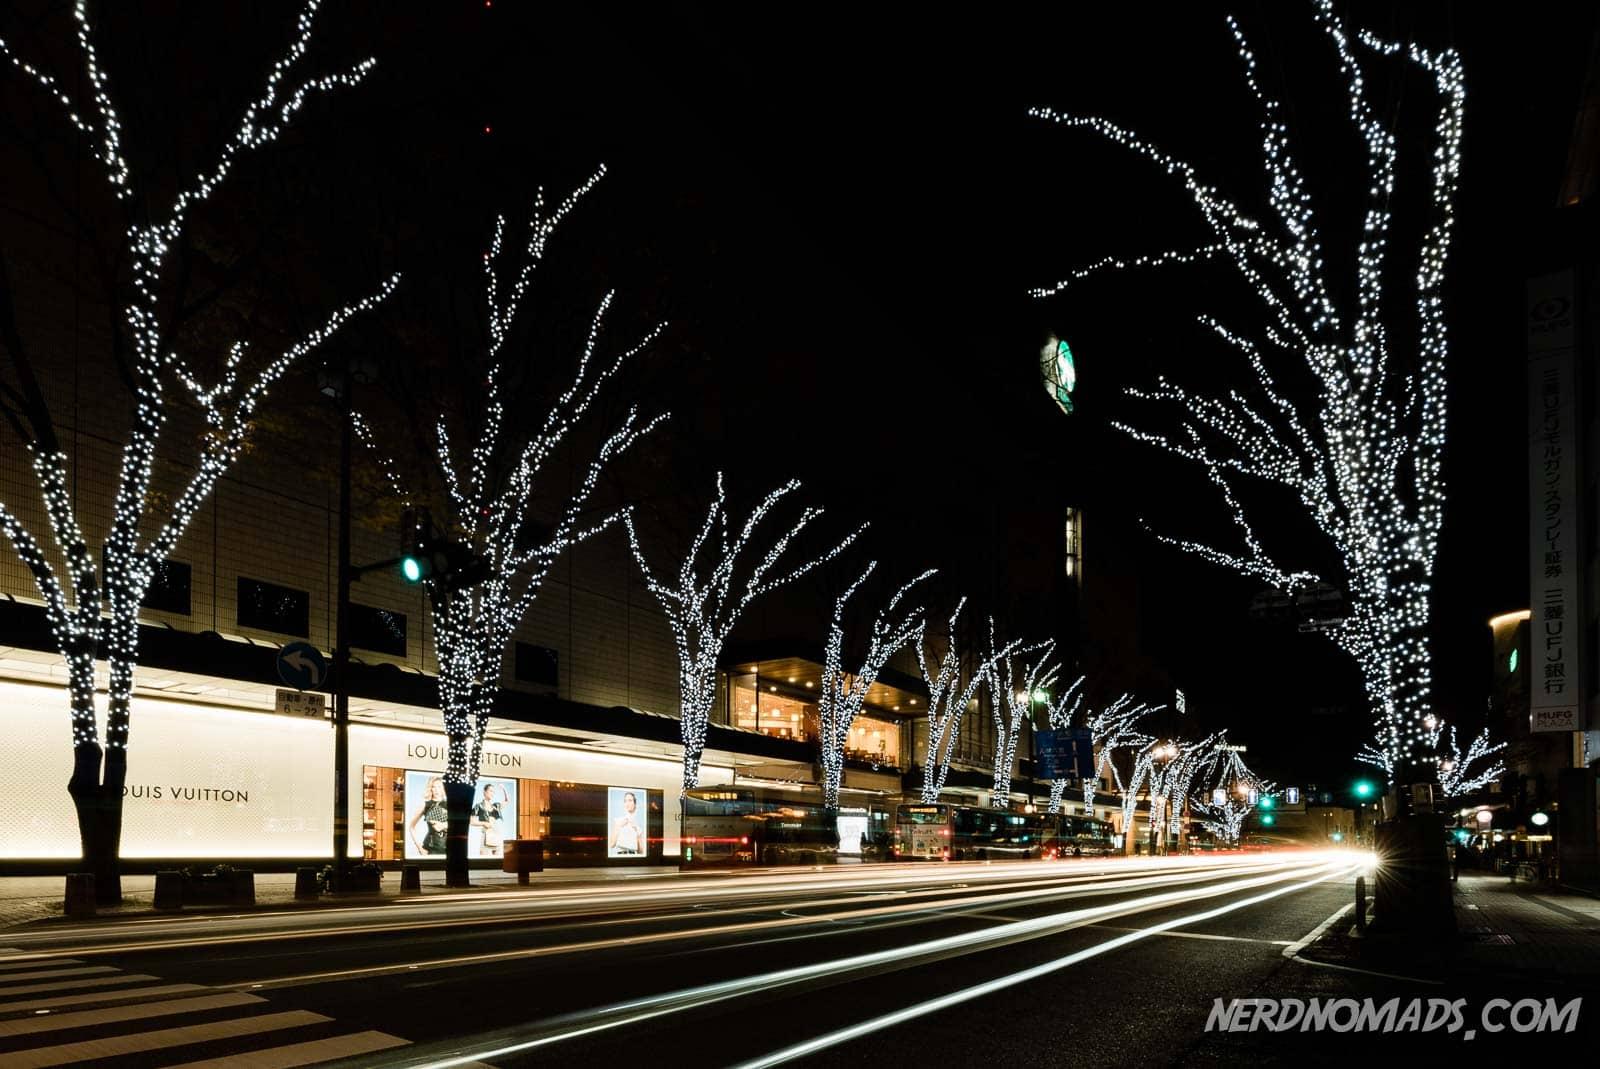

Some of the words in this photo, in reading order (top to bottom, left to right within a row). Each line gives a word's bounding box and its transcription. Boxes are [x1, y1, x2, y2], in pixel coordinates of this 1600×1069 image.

[1537, 710, 1572, 720] MUFG
[407, 743, 444, 761] LOUI
[170, 787, 248, 802] VUITTON
